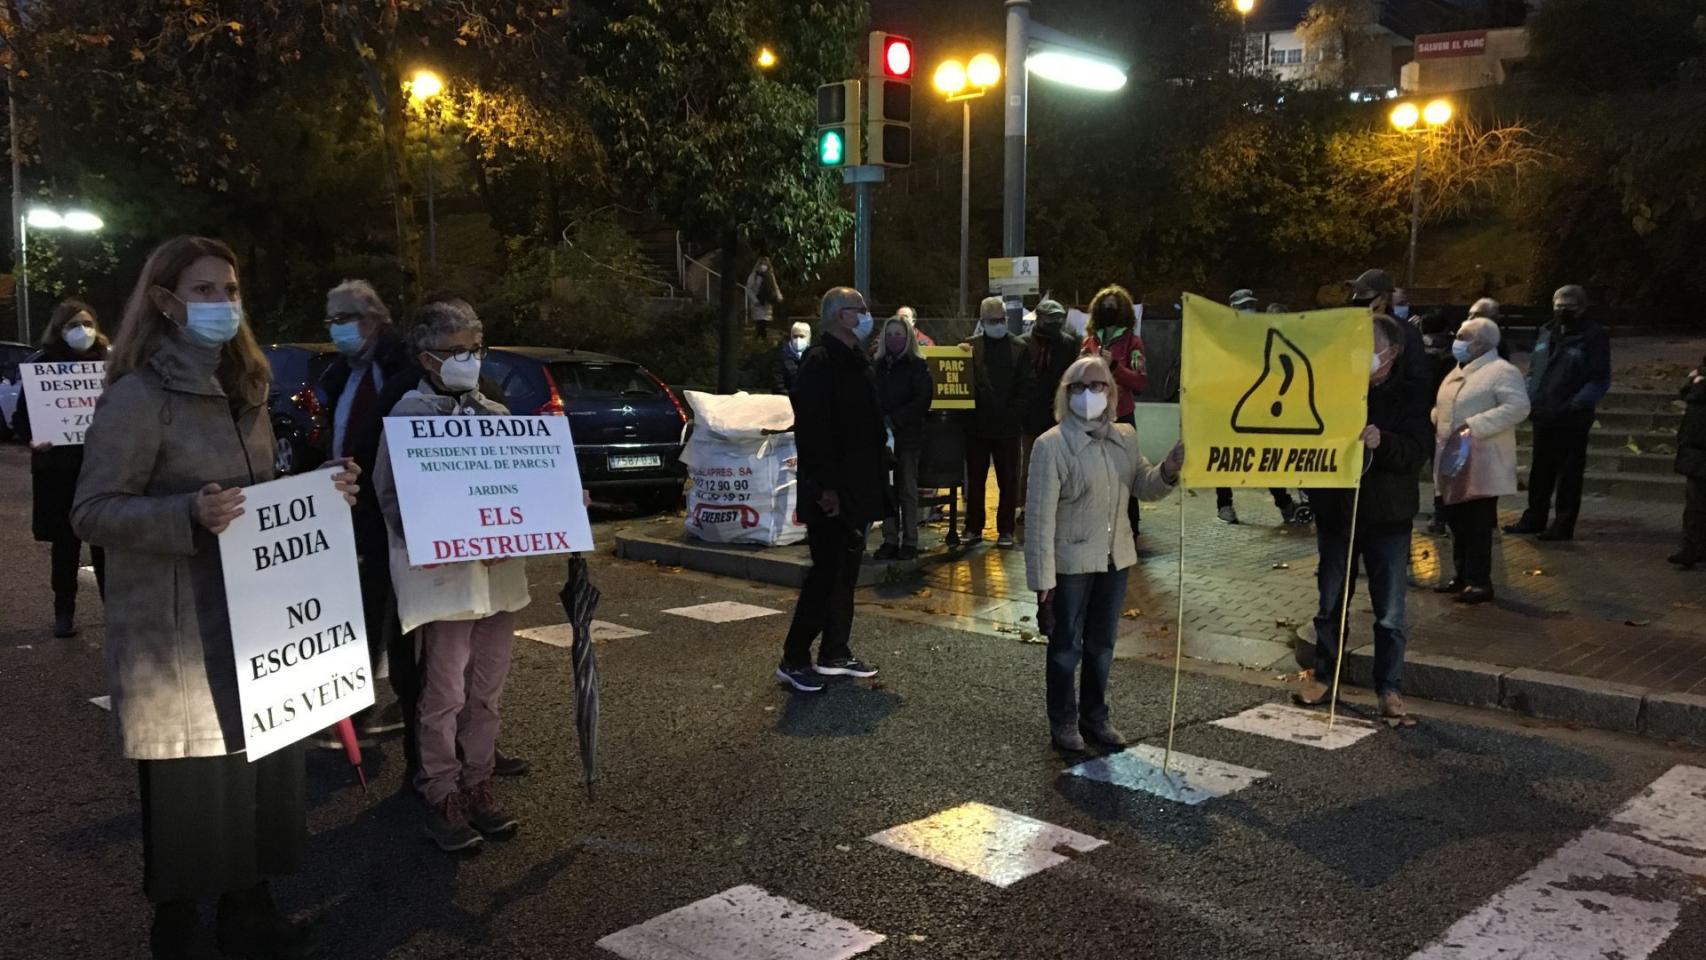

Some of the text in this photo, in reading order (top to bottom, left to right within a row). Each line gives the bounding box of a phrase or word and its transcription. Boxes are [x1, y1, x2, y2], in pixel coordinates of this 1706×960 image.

[1452, 41, 1461, 50] EL
[1463, 38, 1485, 48] PARC
[33, 363, 106, 376] BARCEL
[939, 360, 965, 371] PARC
[946, 371, 959, 383] EN
[40, 379, 104, 392] DESPIE
[937, 383, 970, 395] PERILL
[55, 396, 97, 409] CEM
[410, 418, 552, 438] ELOI BADIA
[406, 445, 561, 458] PRESIDENT DE L'INSTITUT
[420, 458, 556, 472] MUNICIPAL DE PARCS I
[1206, 446, 1338, 473] PARC EN PERILL
[467, 484, 519, 496] JARDINS
[706, 480, 718, 491] 12
[718, 480, 731, 491] 90
[733, 479, 749, 490] 90
[256, 495, 317, 532] ELOI
[478, 506, 524, 527] ELS
[701, 510, 738, 524] EVEREST
[252, 529, 330, 571] BADIA
[432, 531, 571, 560] DESTRUEIX
[286, 598, 322, 629] NO
[250, 621, 357, 681] ESCOLTA
[250, 667, 367, 738] ALS VEÏNS
